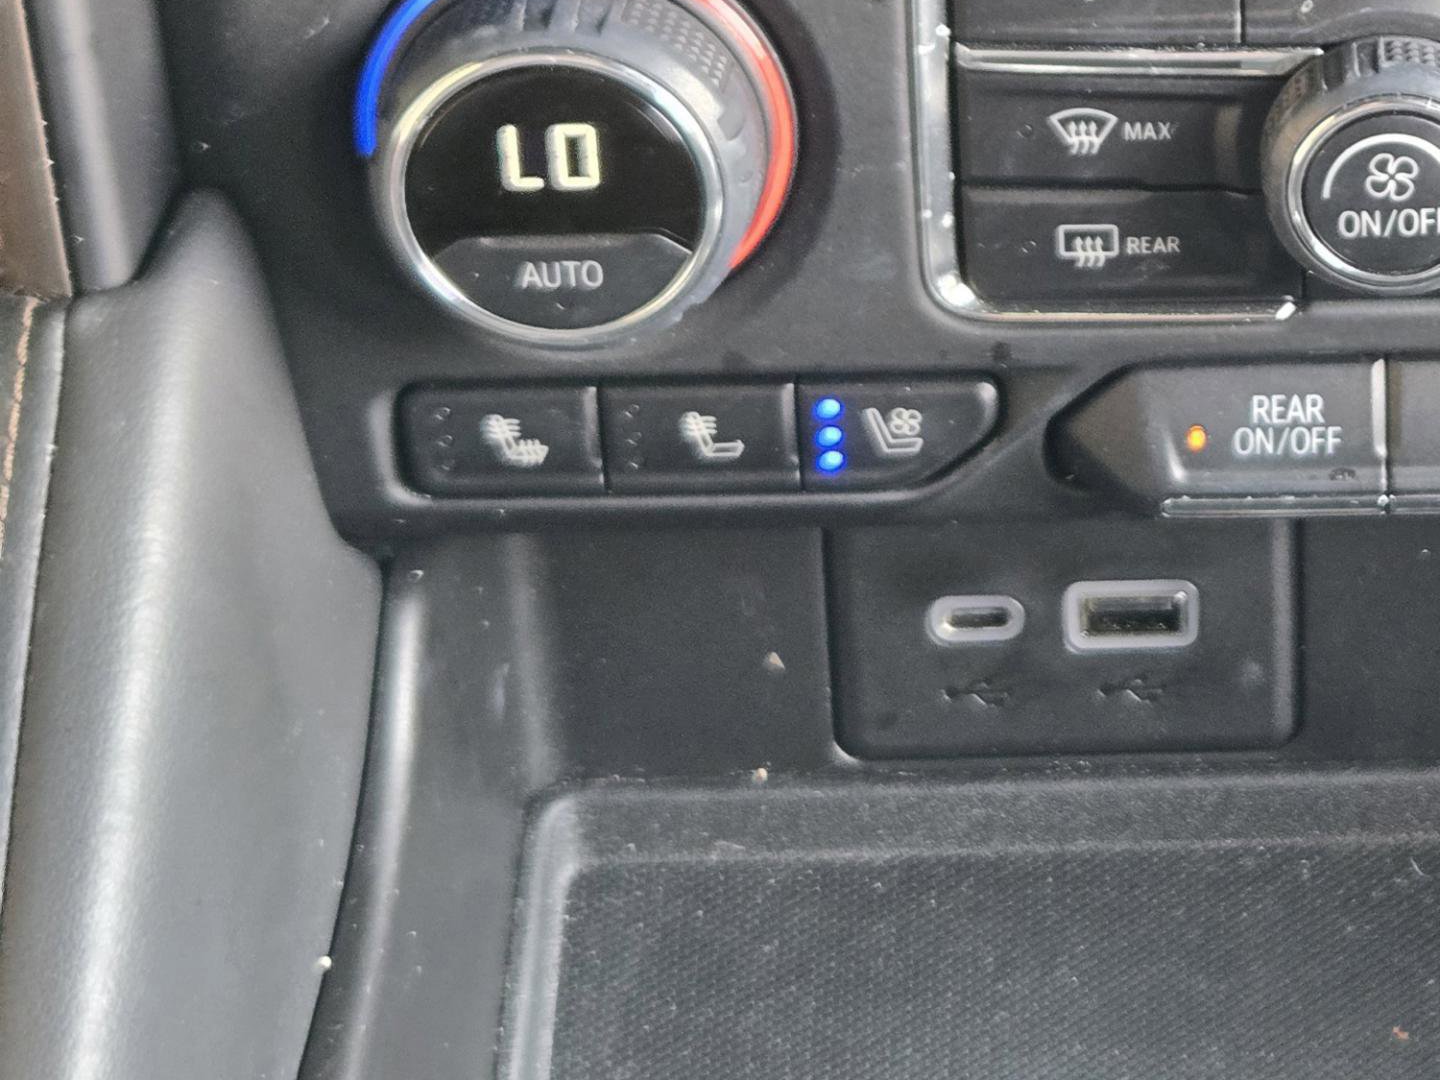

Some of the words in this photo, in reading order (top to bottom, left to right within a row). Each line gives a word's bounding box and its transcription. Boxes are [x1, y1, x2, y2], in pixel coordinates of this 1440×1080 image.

[1123, 121, 1172, 142] MAX
[496, 123, 601, 192] LO
[1126, 236, 1181, 256] REAR
[519, 260, 604, 290] AUTO
[1251, 394, 1325, 424] REAR
[1234, 425, 1342, 457] ON/OFF
